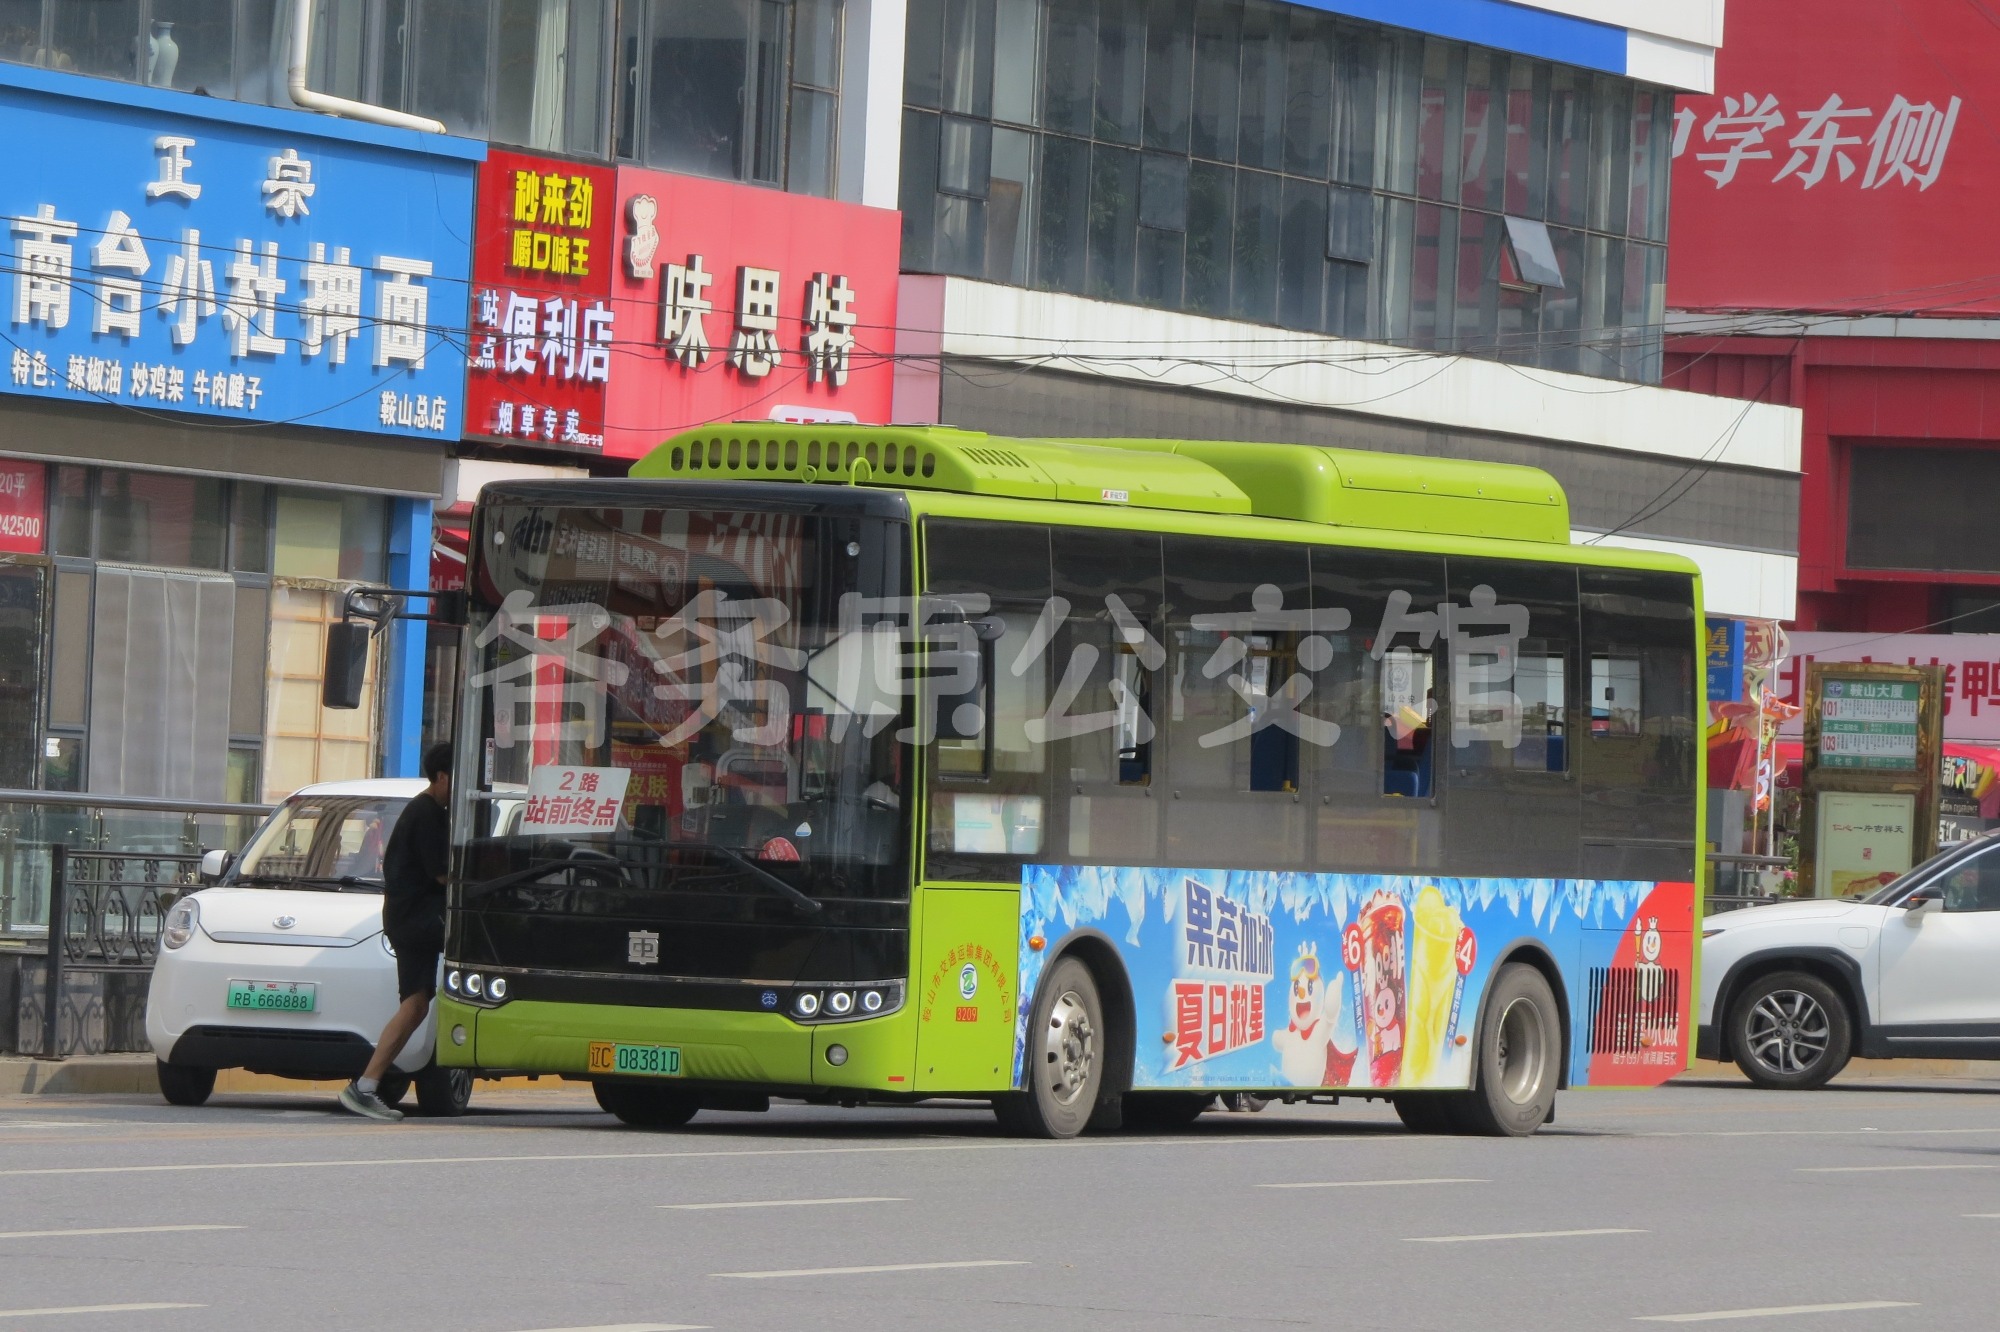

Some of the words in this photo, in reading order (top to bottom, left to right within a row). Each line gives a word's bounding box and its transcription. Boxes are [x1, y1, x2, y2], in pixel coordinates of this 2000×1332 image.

[146, 136, 315, 217] 正宗
[514, 170, 593, 229] 秒来劲
[503, 290, 615, 383] 便利店
[659, 254, 857, 386] 味思特
[131, 361, 184, 402] 炒鸡架
[380, 391, 446, 431] 鞍山总店
[498, 402, 580, 440] 烟草专卖
[1823, 701, 1837, 716] 101
[1850, 684, 1904, 698] 鞍山大厦
[1823, 736, 1836, 751] 103
[558, 771, 599, 793] 2路
[524, 794, 619, 826] 站前终点
[1185, 879, 1273, 975] 果茶加冰
[957, 1008, 977, 1021] 3209
[1175, 983, 1264, 1067] 夏日救星
[619, 1047, 679, 1072] 08381D
